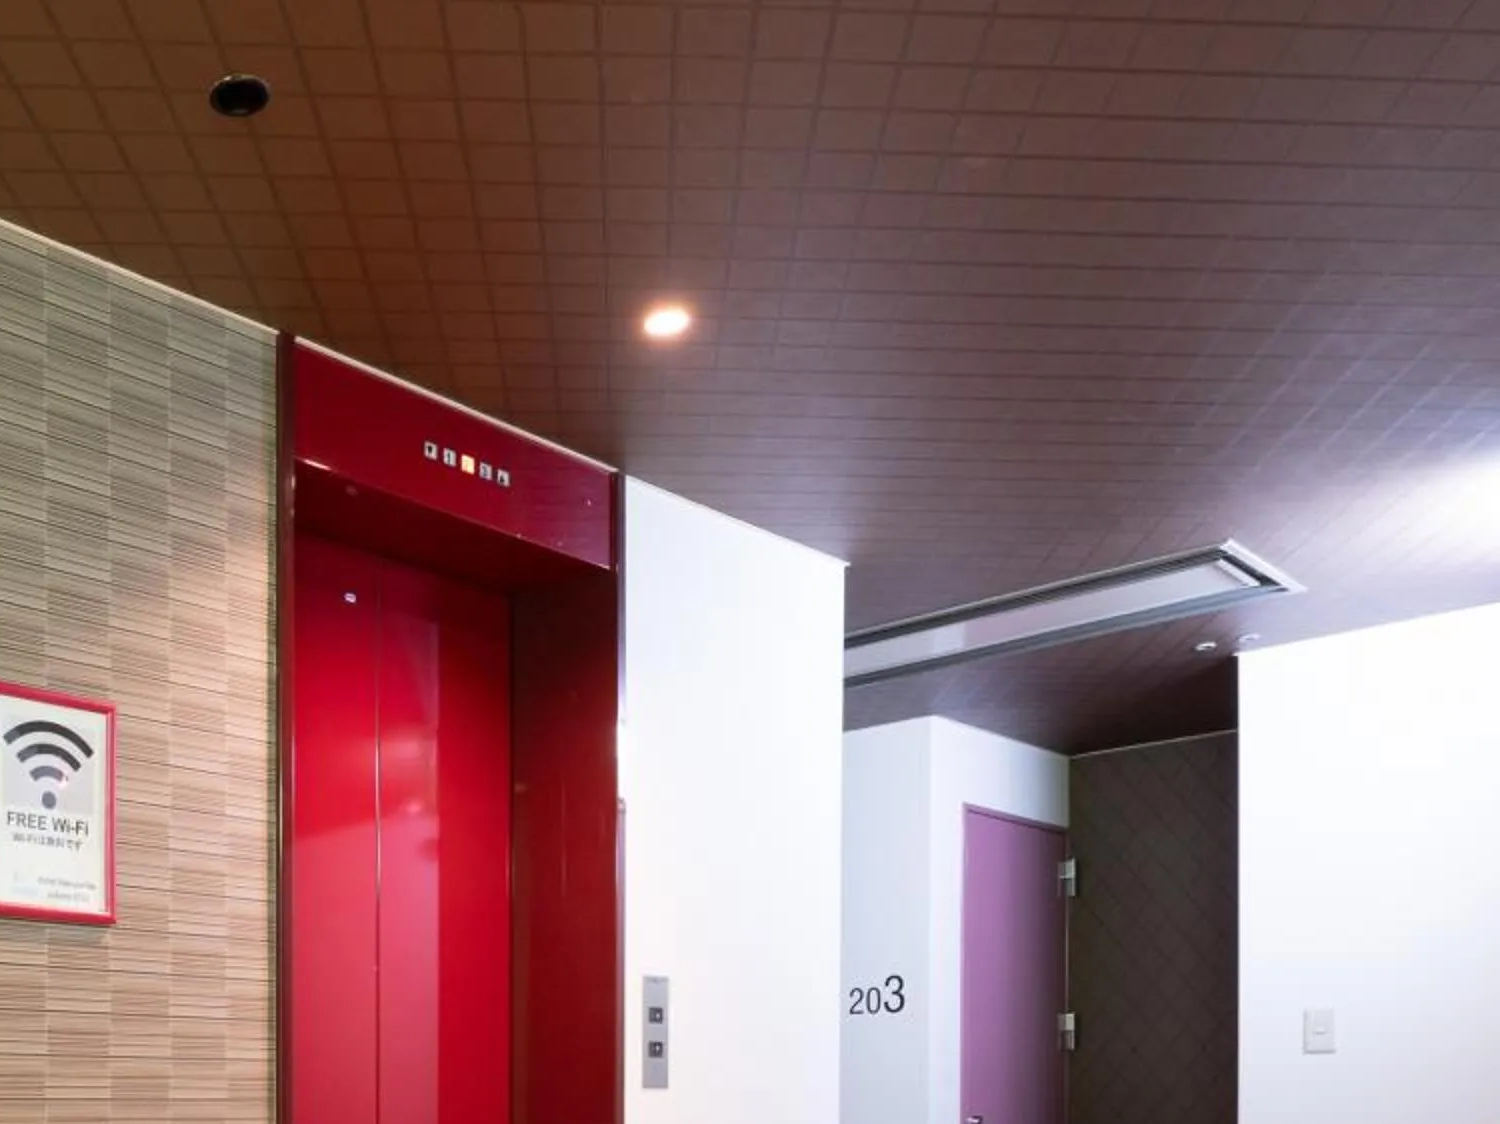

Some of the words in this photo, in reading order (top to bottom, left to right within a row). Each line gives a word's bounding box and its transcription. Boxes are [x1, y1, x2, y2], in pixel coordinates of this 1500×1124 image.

[6, 811, 48, 831] FREE
[52, 816, 89, 837] Wi-Fi
[849, 975, 905, 1015] 203
